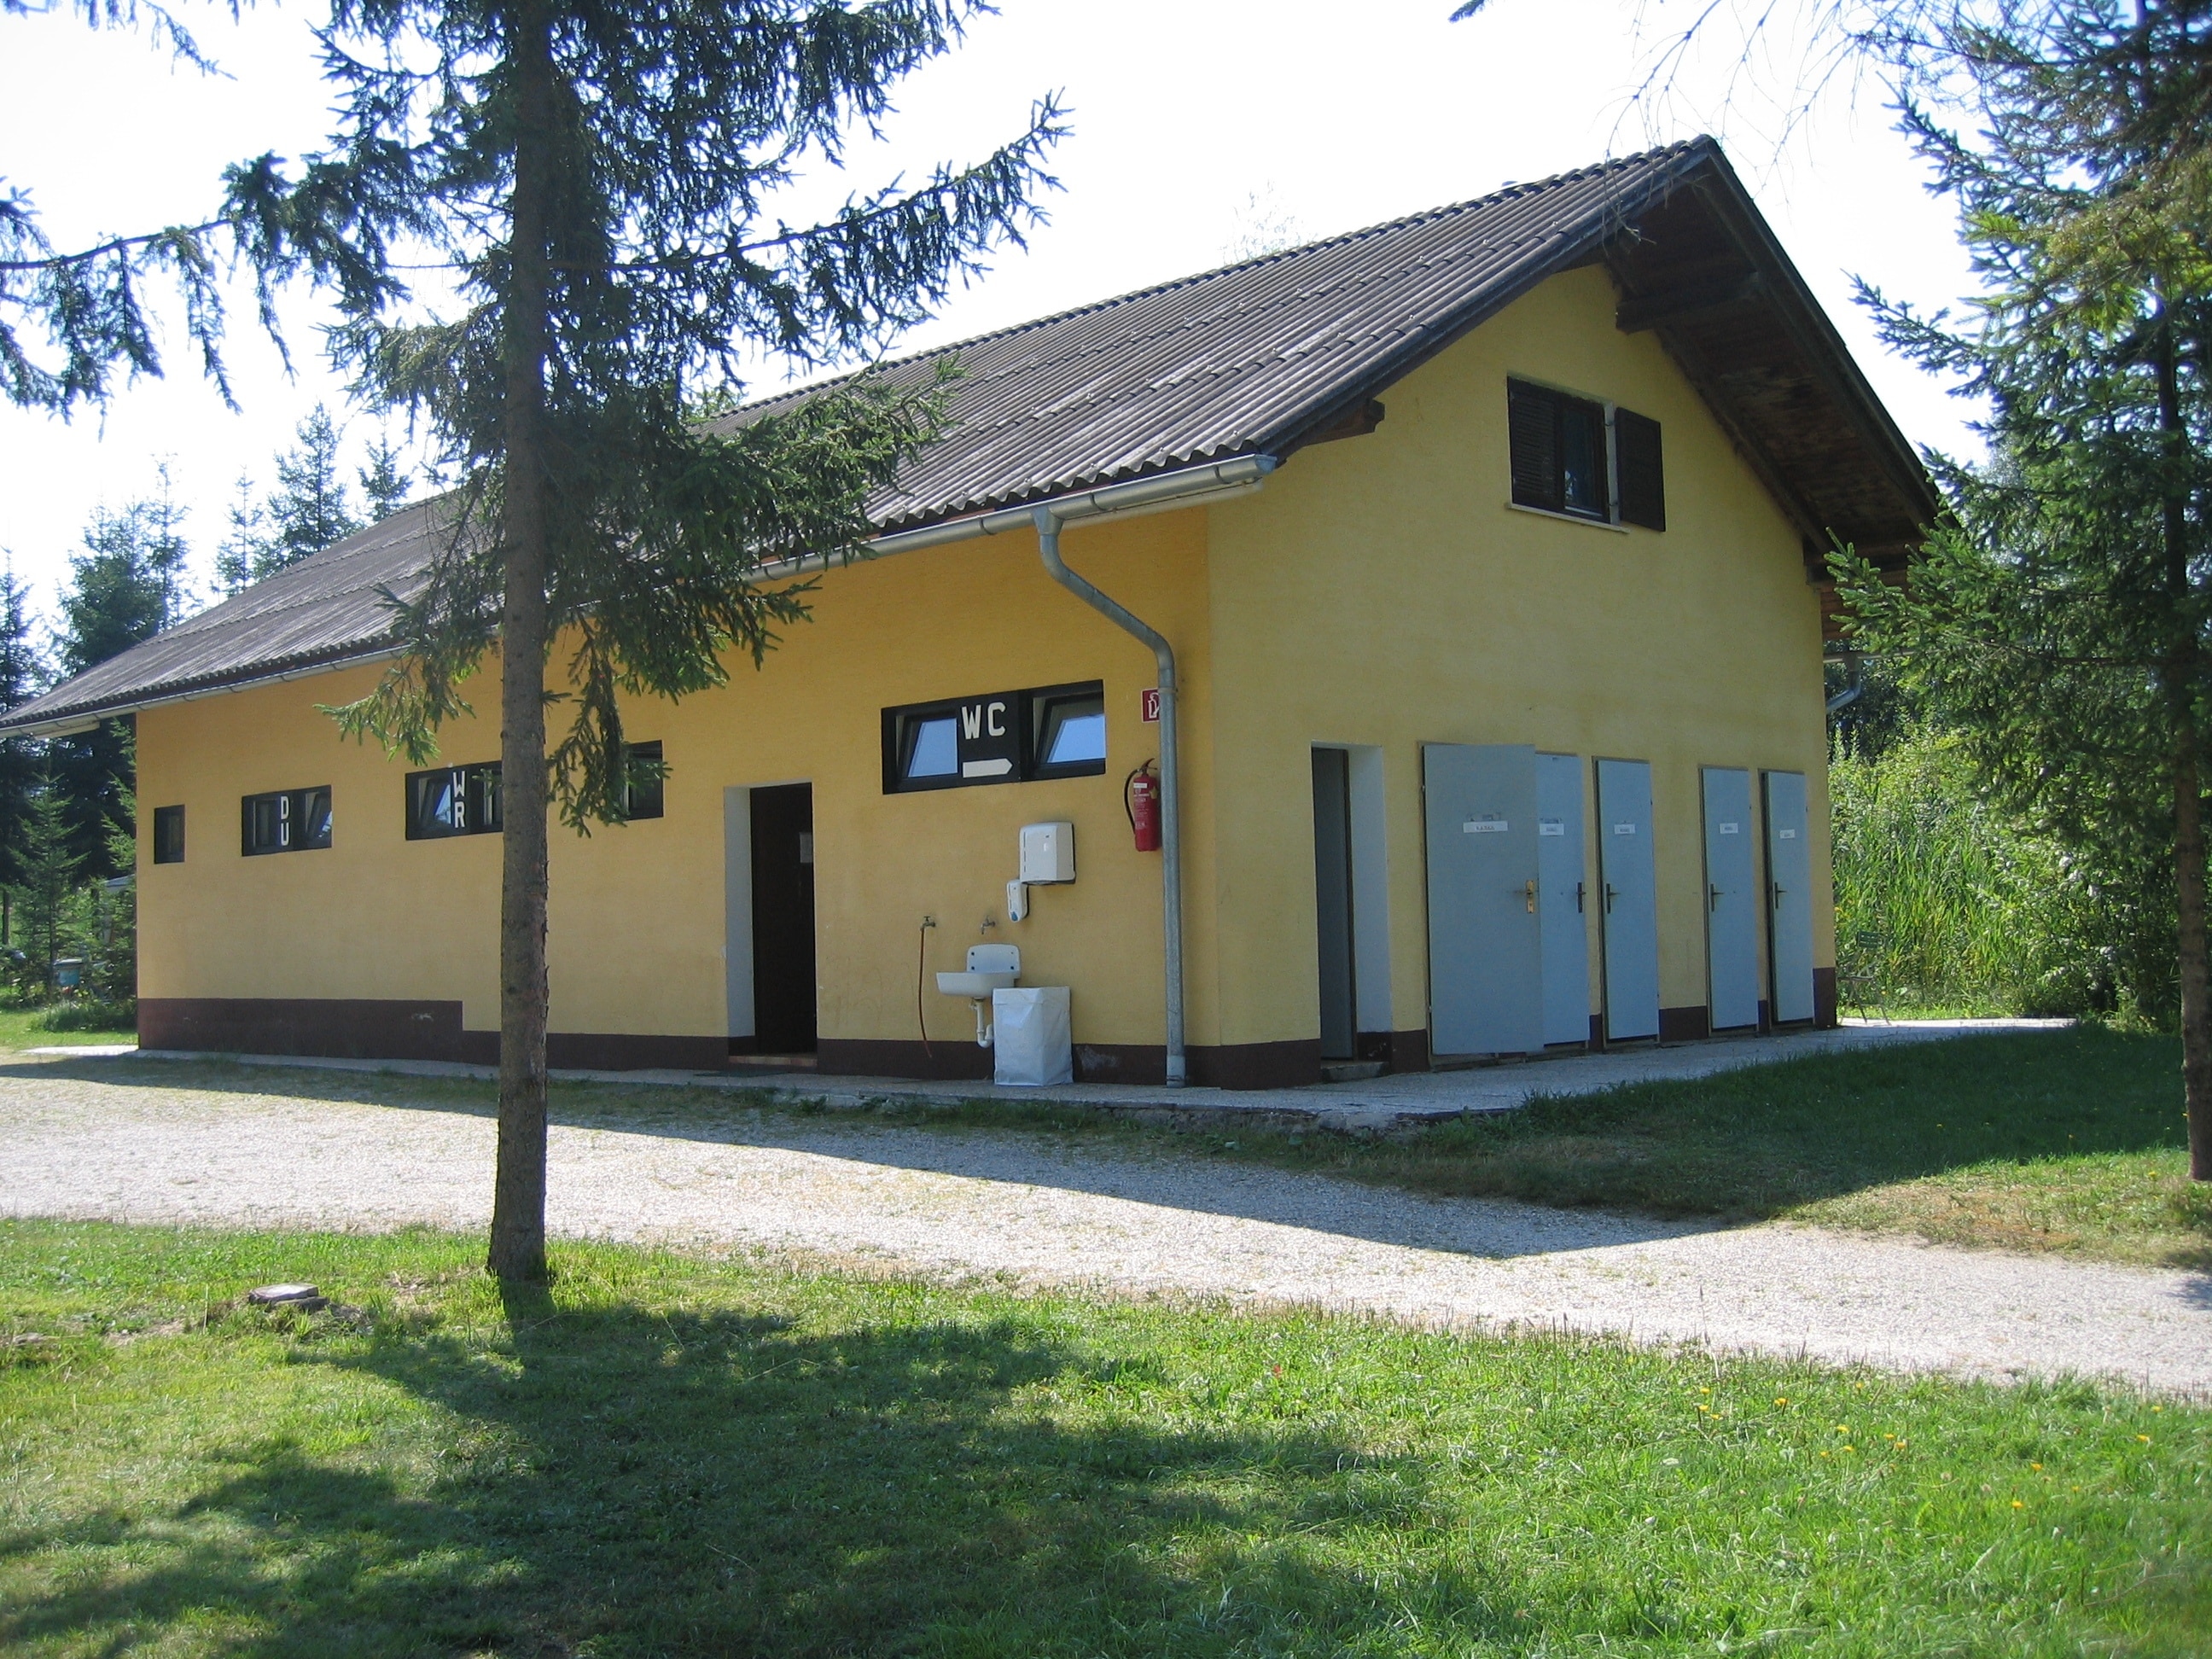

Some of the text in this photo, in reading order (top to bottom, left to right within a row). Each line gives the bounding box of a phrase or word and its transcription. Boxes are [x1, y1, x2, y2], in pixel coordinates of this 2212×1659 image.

[961, 701, 1006, 740] WC
[280, 795, 289, 847] DU
[452, 771, 466, 829] WR
